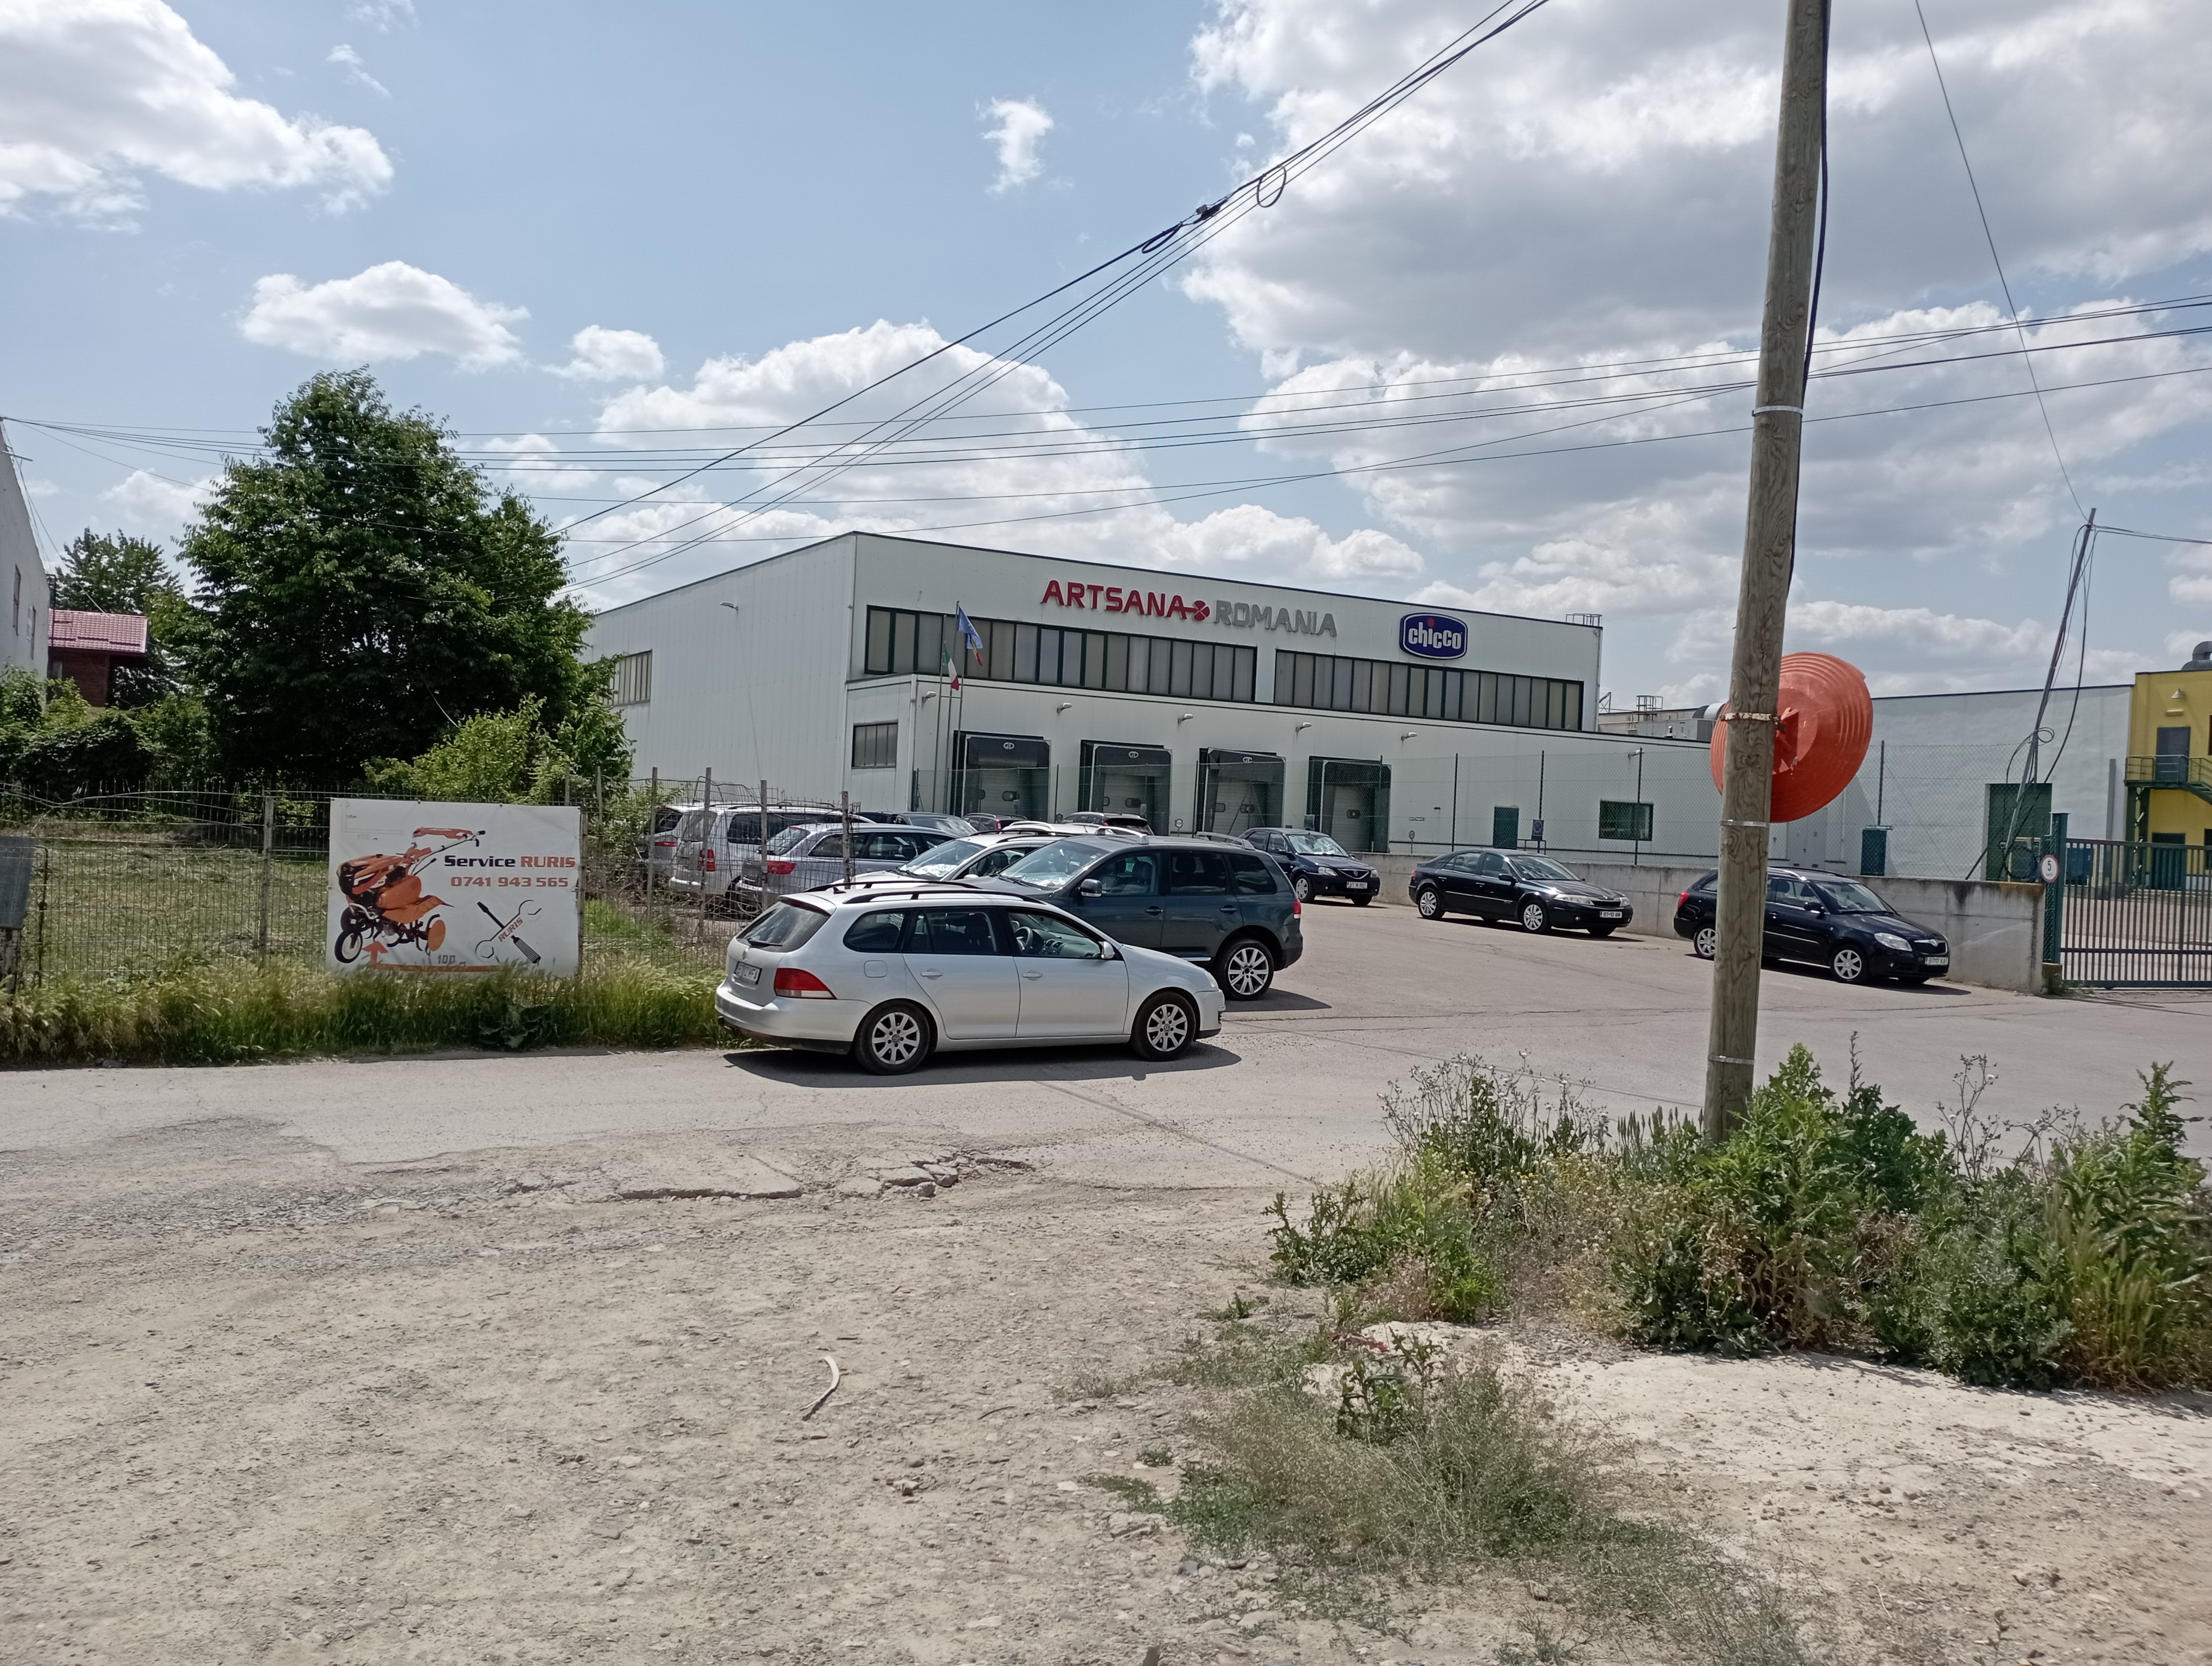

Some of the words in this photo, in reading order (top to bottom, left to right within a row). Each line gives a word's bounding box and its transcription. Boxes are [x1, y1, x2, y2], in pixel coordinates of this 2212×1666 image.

[1040, 580, 1188, 620] ARTSANA
[1214, 599, 1338, 637] ROMANIA
[444, 855, 516, 867] Service
[520, 856, 576, 868] RURIS
[2047, 860, 2052, 872] 5
[451, 876, 491, 887] 0741
[498, 877, 532, 887] 943
[536, 877, 569, 887] 565
[498, 917, 524, 943] RURIS
